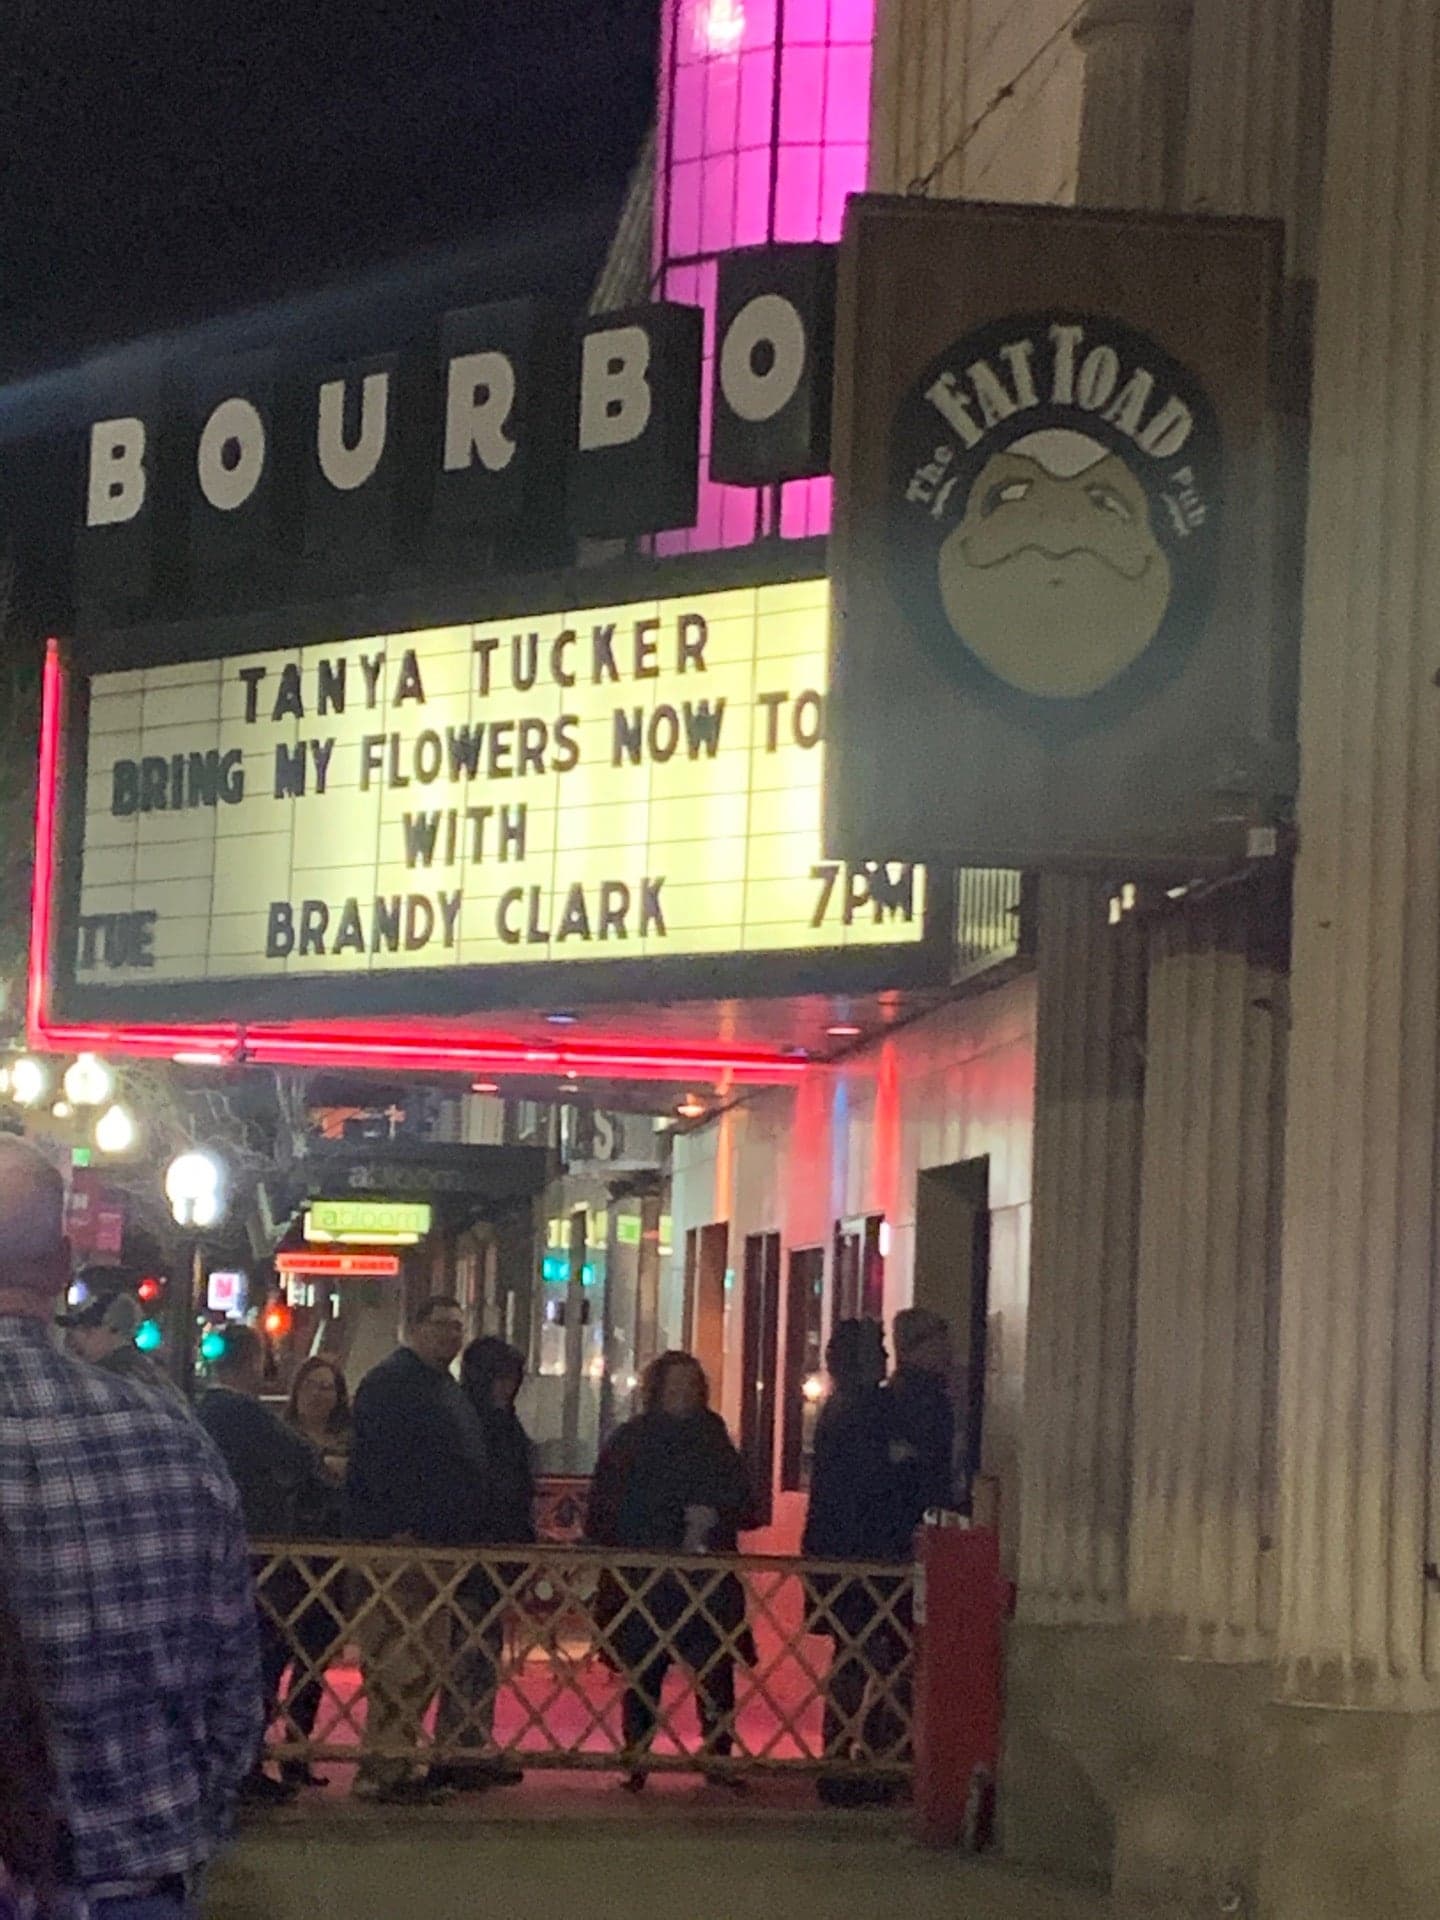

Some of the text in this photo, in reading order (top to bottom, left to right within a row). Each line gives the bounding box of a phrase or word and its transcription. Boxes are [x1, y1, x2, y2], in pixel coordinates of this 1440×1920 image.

[239, 613, 708, 723] TANYA TUCKER
[112, 748, 245, 816] BRING
[274, 738, 335, 799] MY
[360, 715, 580, 791] FLOWERS
[612, 698, 726, 767] NOW
[403, 803, 527, 869] WITH
[266, 889, 462, 958] BRANDY
[497, 876, 666, 944] CLARK
[809, 862, 913, 928] 7PM
